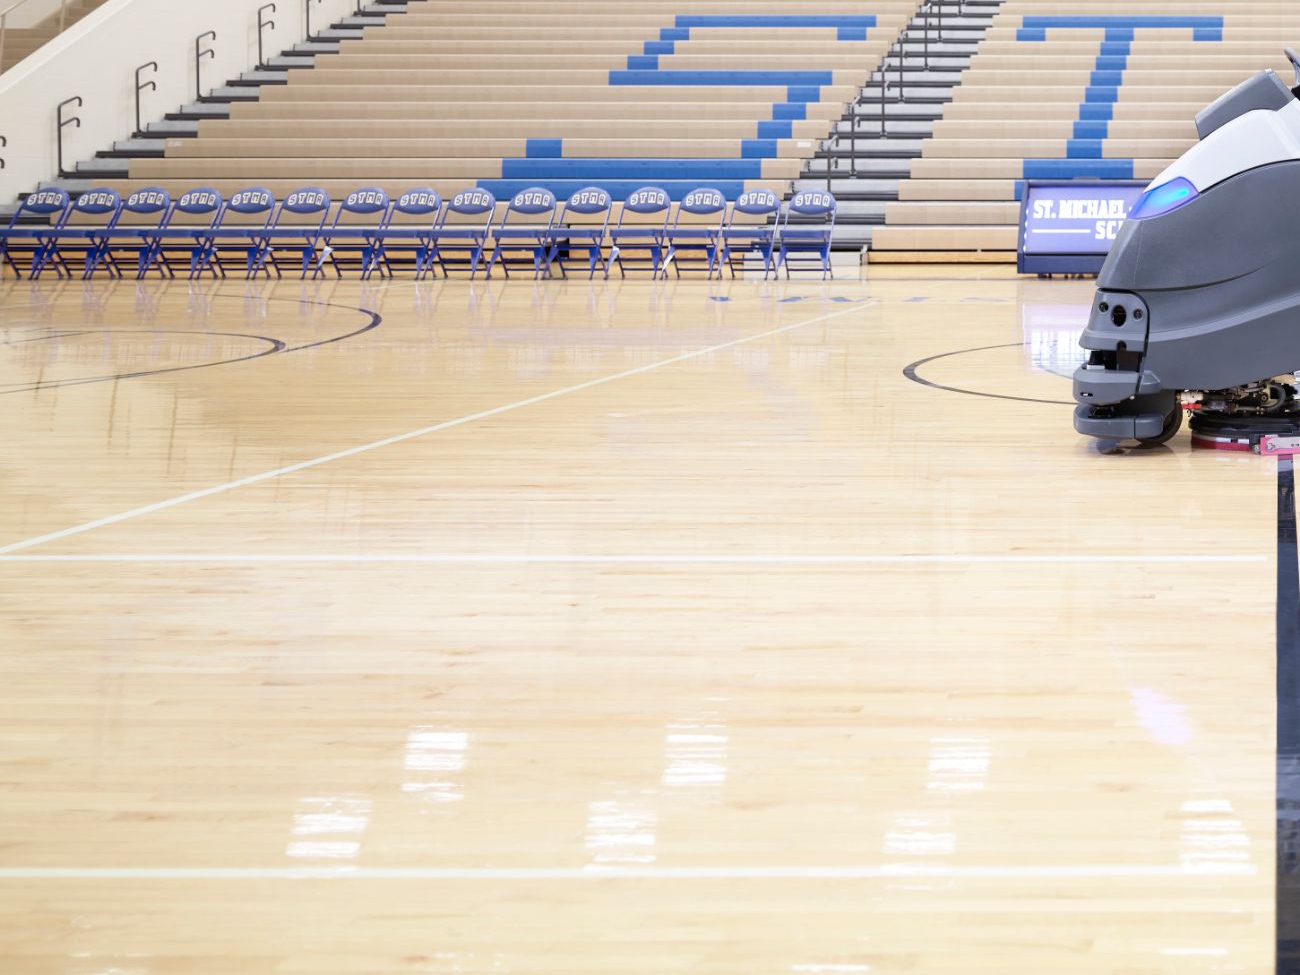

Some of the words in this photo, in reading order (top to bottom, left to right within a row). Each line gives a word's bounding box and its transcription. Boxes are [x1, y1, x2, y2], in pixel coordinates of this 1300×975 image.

[27, 193, 62, 205] STMA
[78, 193, 114, 206] STMA
[128, 192, 163, 205] STMA
[180, 193, 216, 206] STMA
[232, 192, 269, 205] STMA
[288, 193, 323, 205] STMA
[348, 192, 383, 205] STMA
[400, 193, 435, 206] STMA
[454, 193, 489, 206] STMA
[515, 193, 550, 206] STMA
[571, 193, 606, 205] STMA
[630, 192, 664, 205] STMA
[686, 193, 720, 206] STMA
[740, 193, 774, 206] STMA
[795, 193, 830, 207] STMA
[1033, 200, 1056, 218] ST.
[1095, 220, 1124, 240] SC
